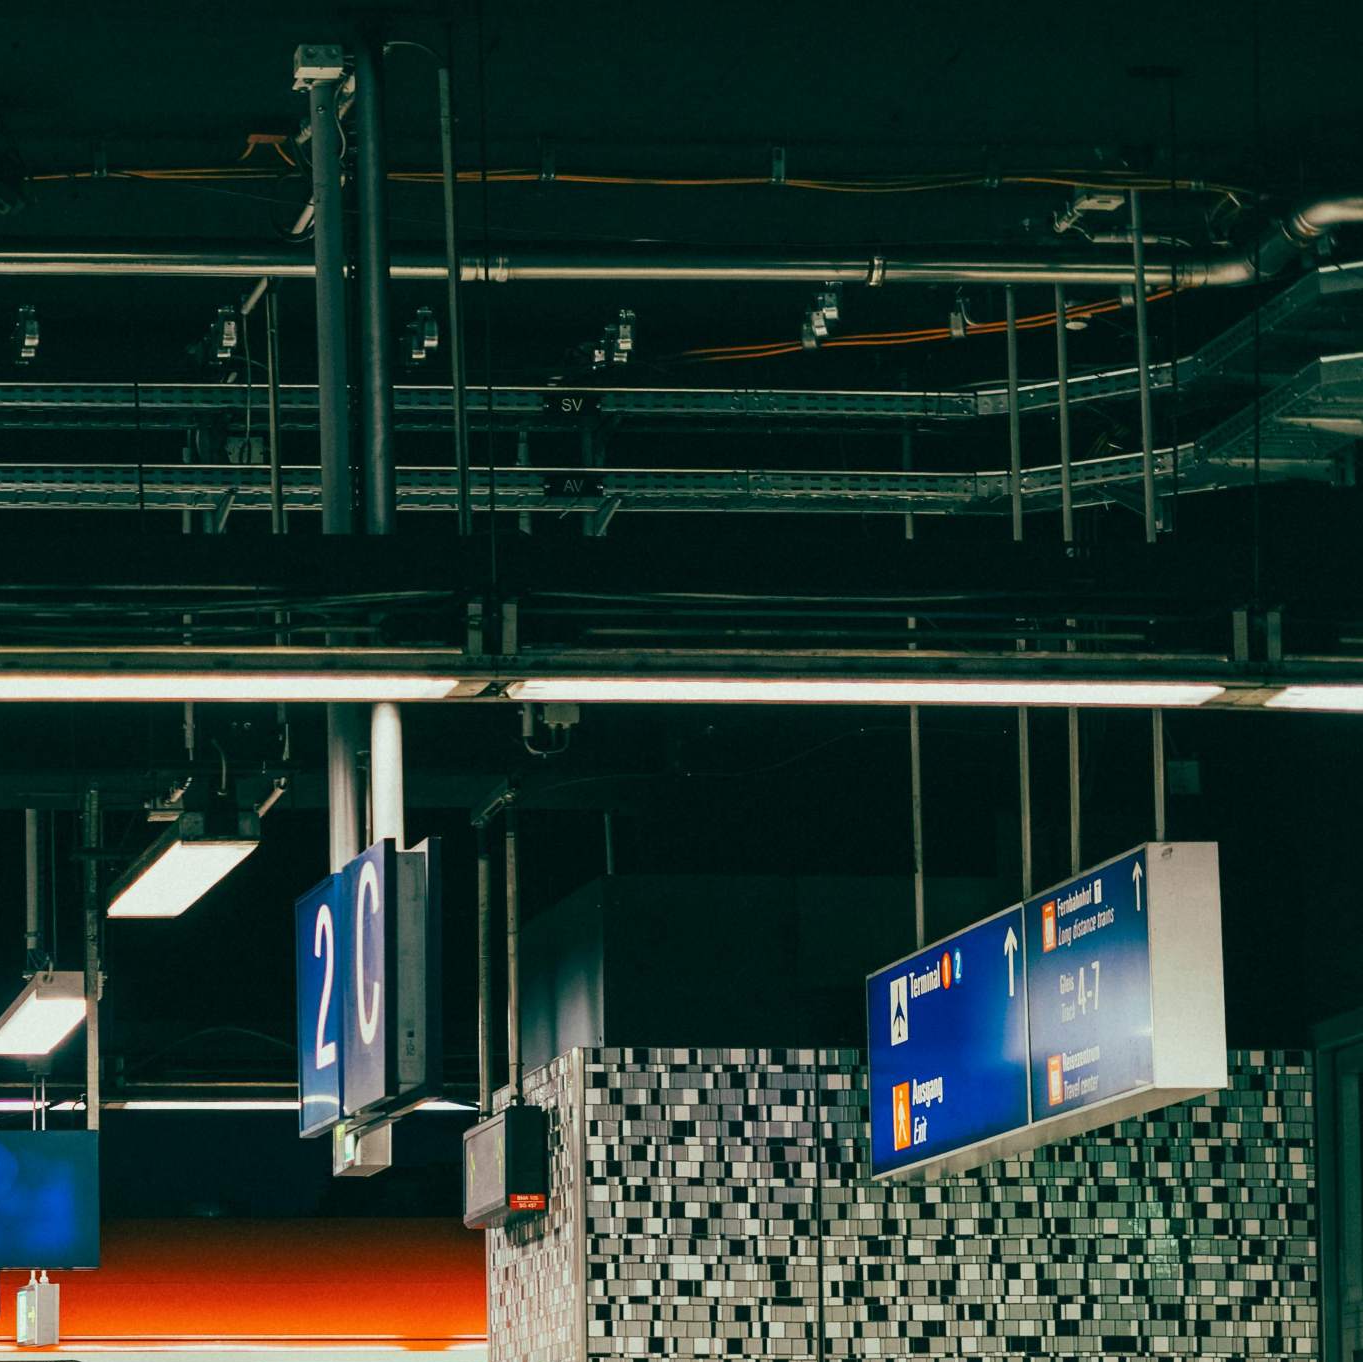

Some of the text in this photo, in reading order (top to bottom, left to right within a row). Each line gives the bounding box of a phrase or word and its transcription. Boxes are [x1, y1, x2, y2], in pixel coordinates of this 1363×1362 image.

[561, 398, 583, 412] SV
[563, 479, 584, 493] AV
[1057, 882, 1092, 918] Fernbahnhof
[1058, 904, 1114, 947] Long distance trains
[356, 860, 380, 1046] C
[314, 904, 336, 1070] 2
[909, 961, 941, 999] Terminal
[955, 950, 961, 980] 2
[1060, 972, 1074, 994] Gleis
[1078, 961, 1100, 1015] 4-7
[912, 1076, 943, 1108] Ausgang
[914, 1116, 927, 1145] Exit
